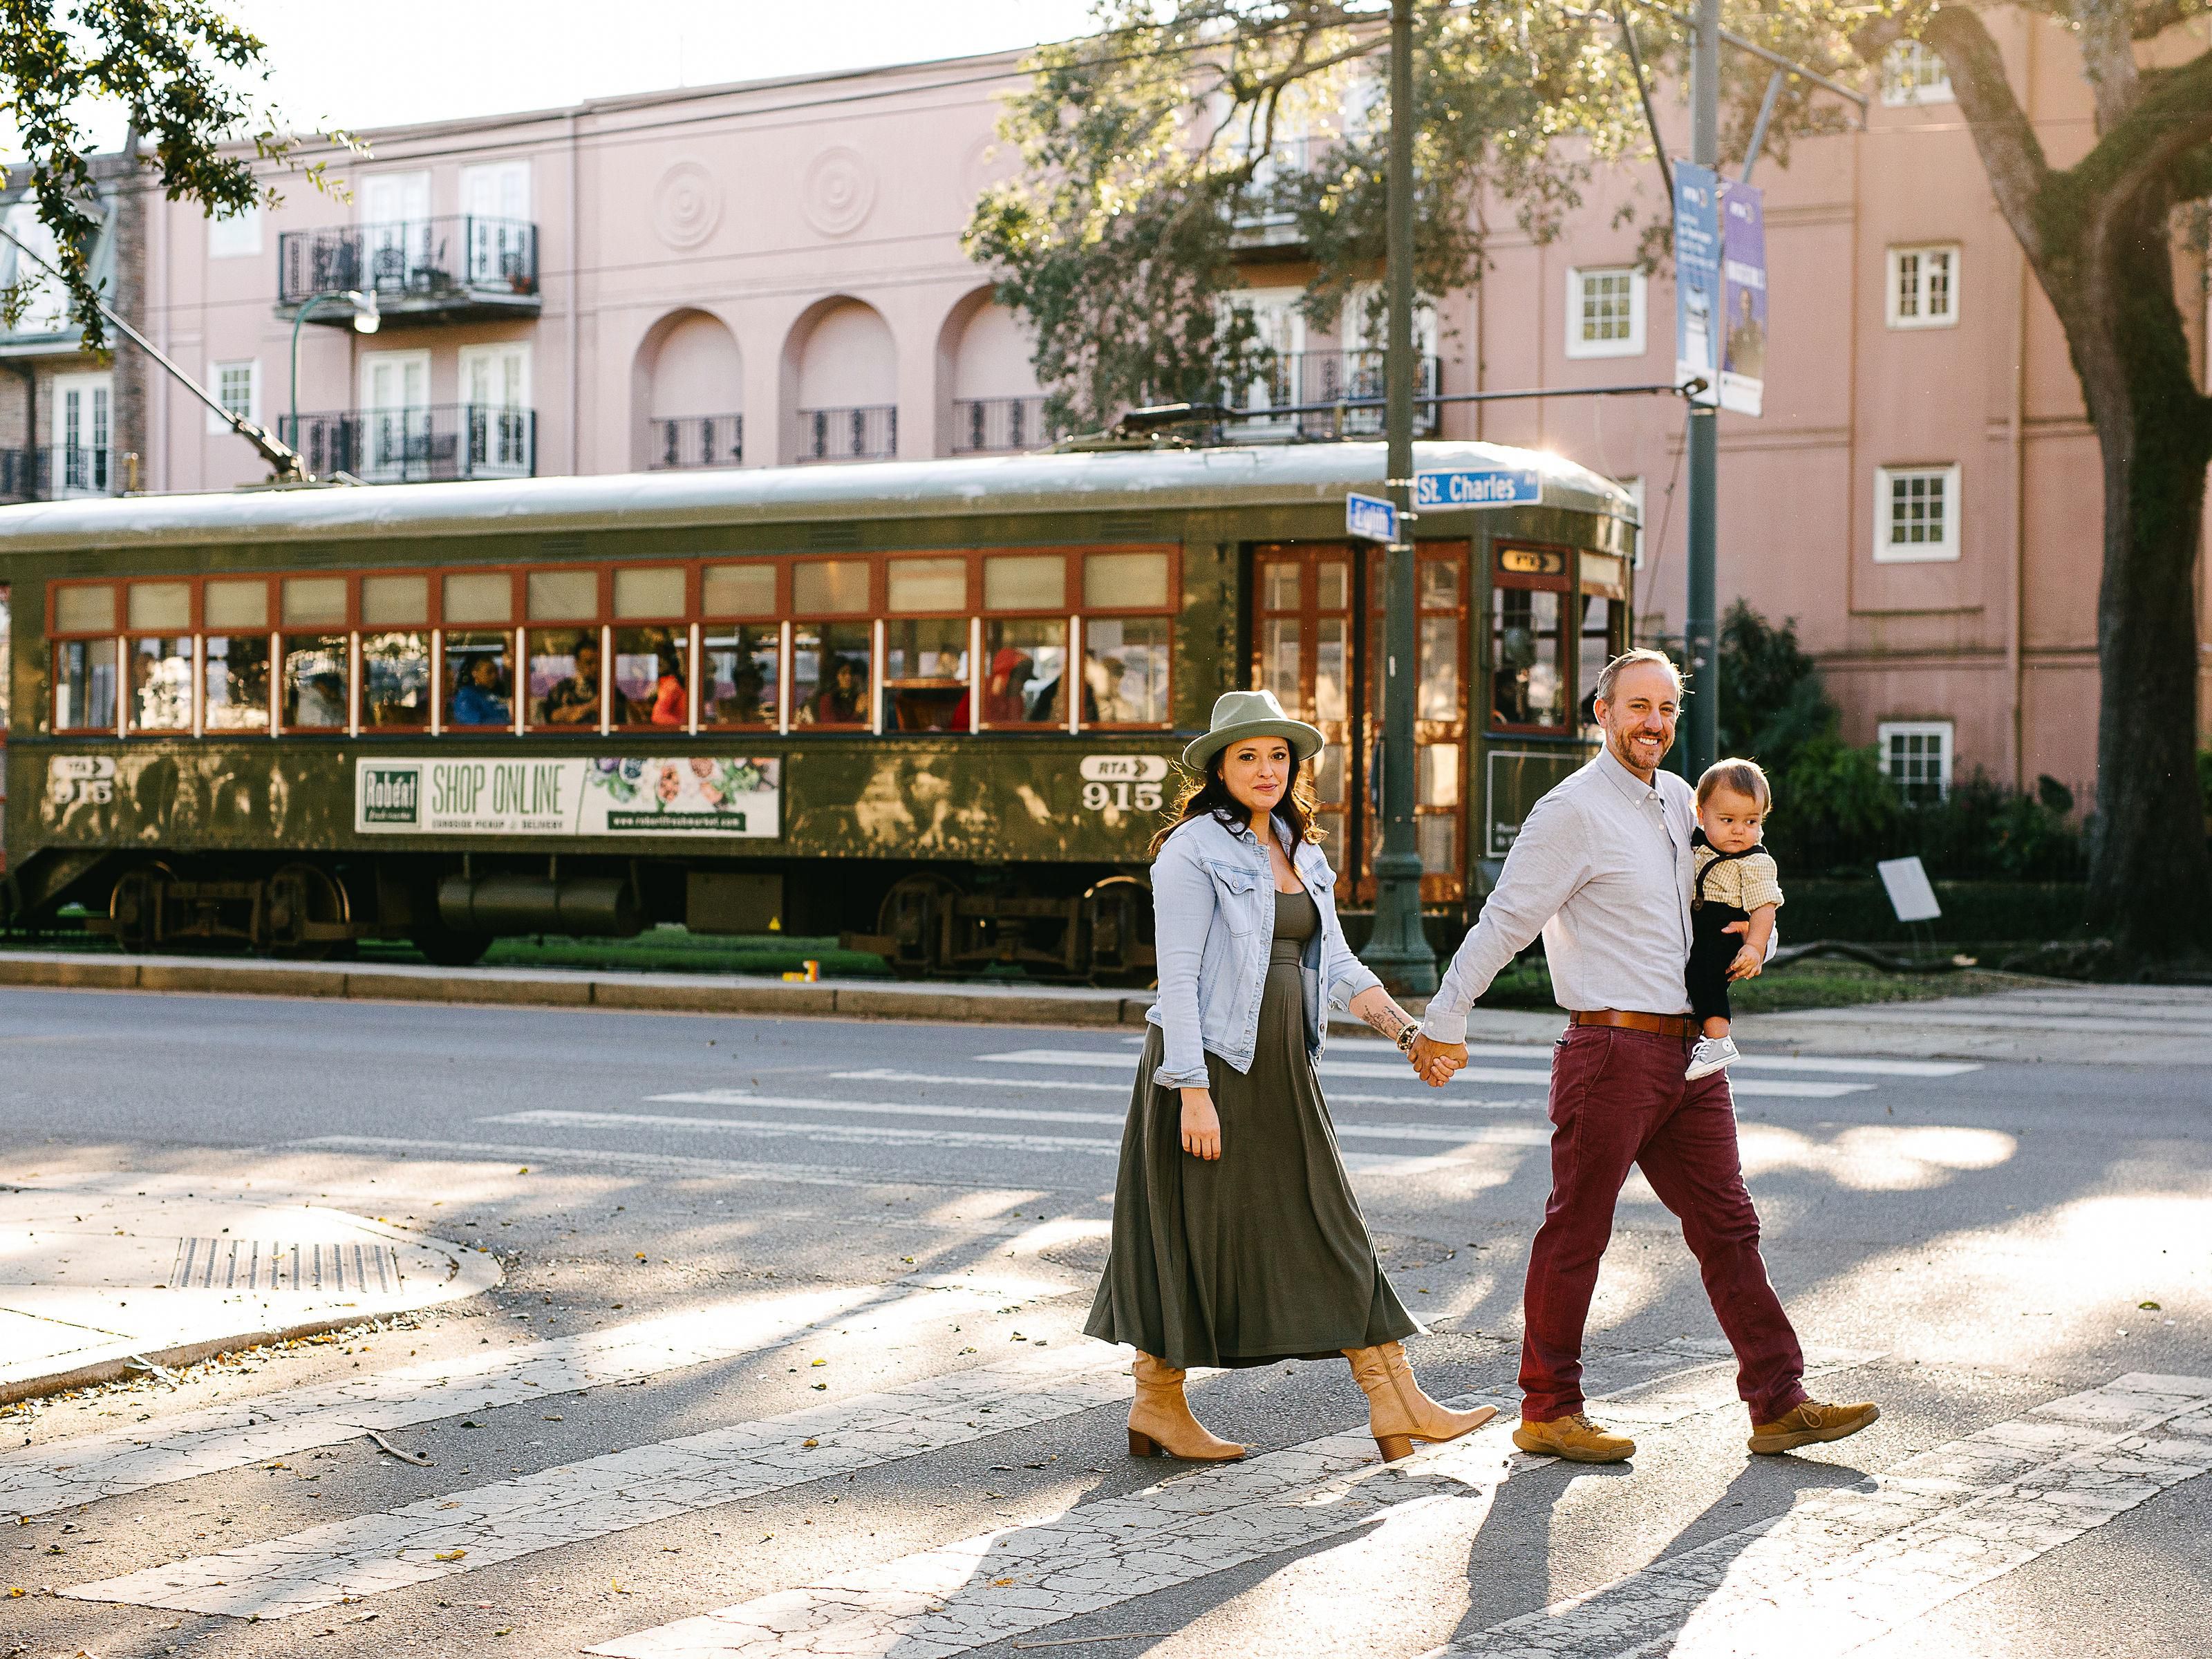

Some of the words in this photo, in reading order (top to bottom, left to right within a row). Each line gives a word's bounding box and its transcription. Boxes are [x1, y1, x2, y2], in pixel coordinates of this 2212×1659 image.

[1449, 475, 1516, 502] Charles
[1098, 762, 1128, 775] RTA
[432, 764, 485, 814] SHOP
[493, 764, 565, 814] ONLINE
[1082, 782, 1163, 812] 915
[522, 819, 563, 829] DELIVERY
